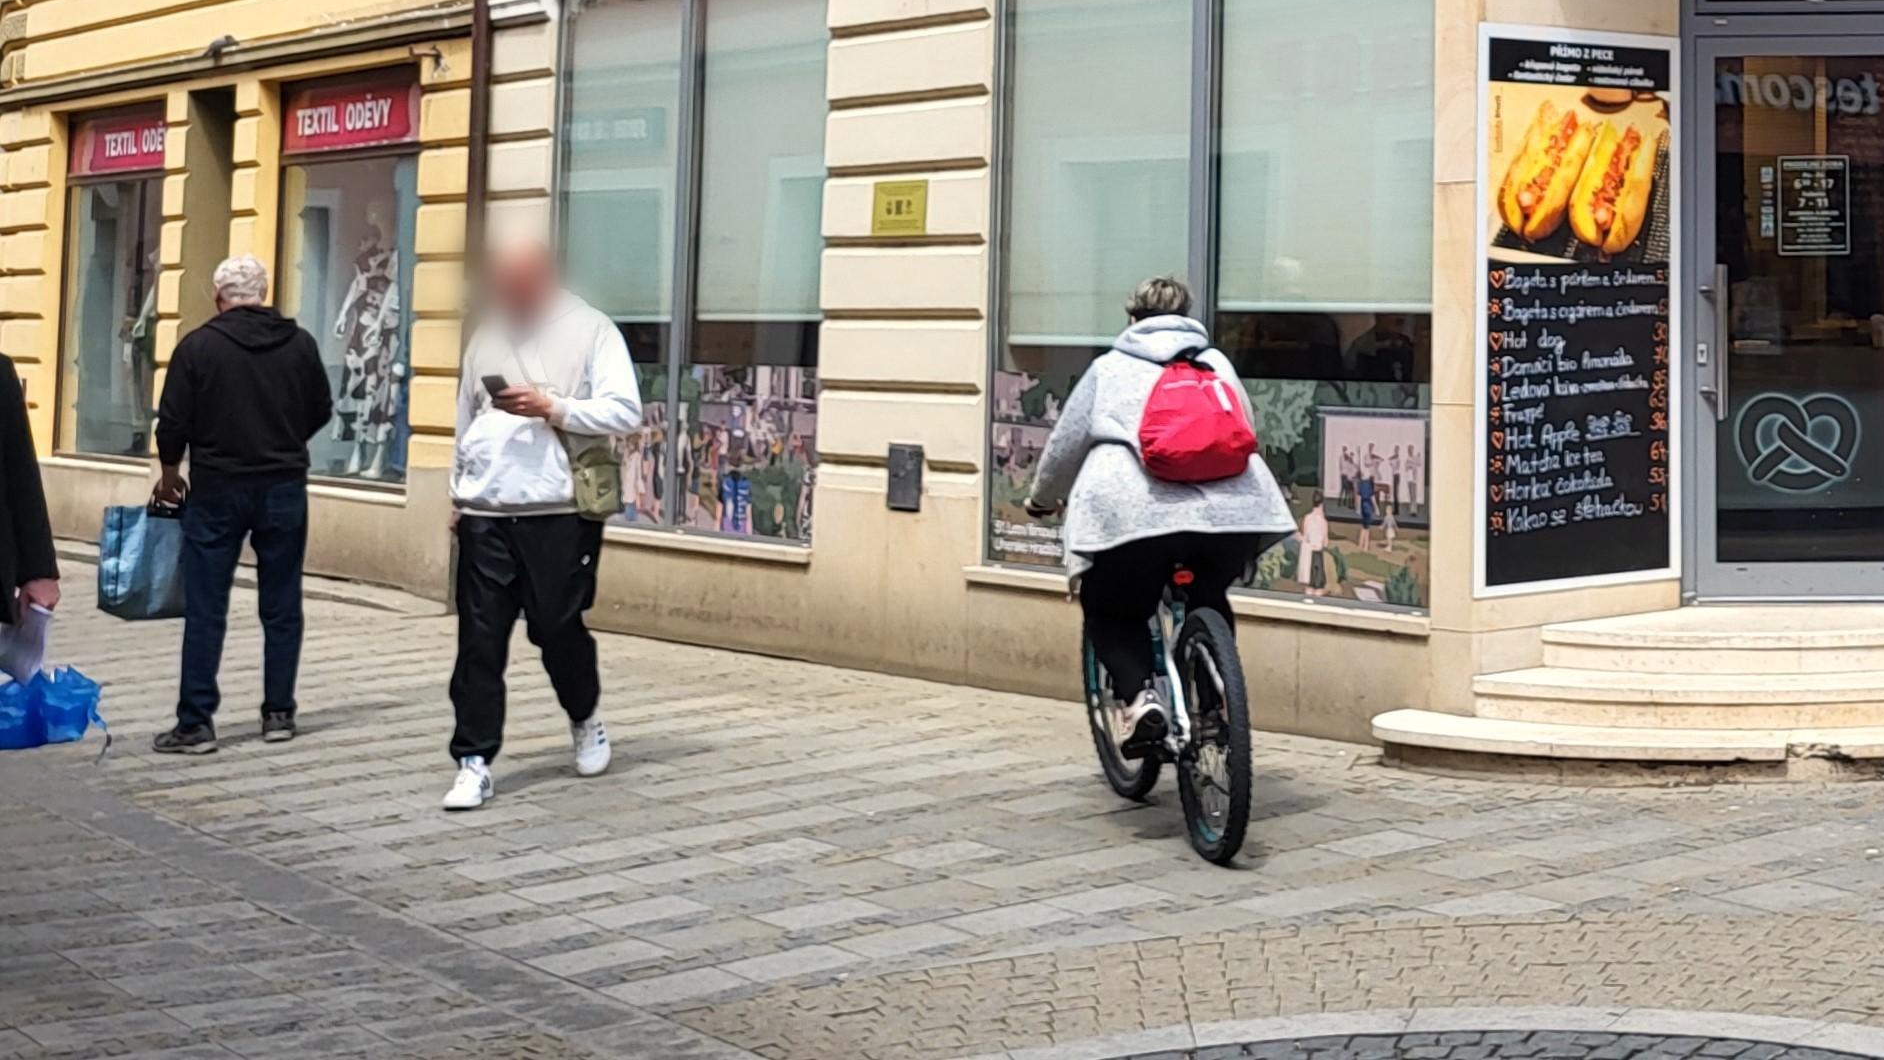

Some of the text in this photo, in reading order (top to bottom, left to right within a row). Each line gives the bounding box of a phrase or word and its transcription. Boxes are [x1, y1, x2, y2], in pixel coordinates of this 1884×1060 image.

[1583, 49, 1590, 59] Z
[1591, 49, 1614, 61] PECE
[296, 93, 393, 137] TEXTIL ODĚVY
[104, 120, 167, 158] TEXTIL ODĚ
[1504, 267, 1547, 294] Bageta
[1503, 297, 1547, 325] Bageta
[1503, 327, 1566, 355] Hot dog
[1504, 426, 1536, 450] Hot
[1541, 420, 1580, 452] Apple
[1507, 506, 1547, 534] Kakao
